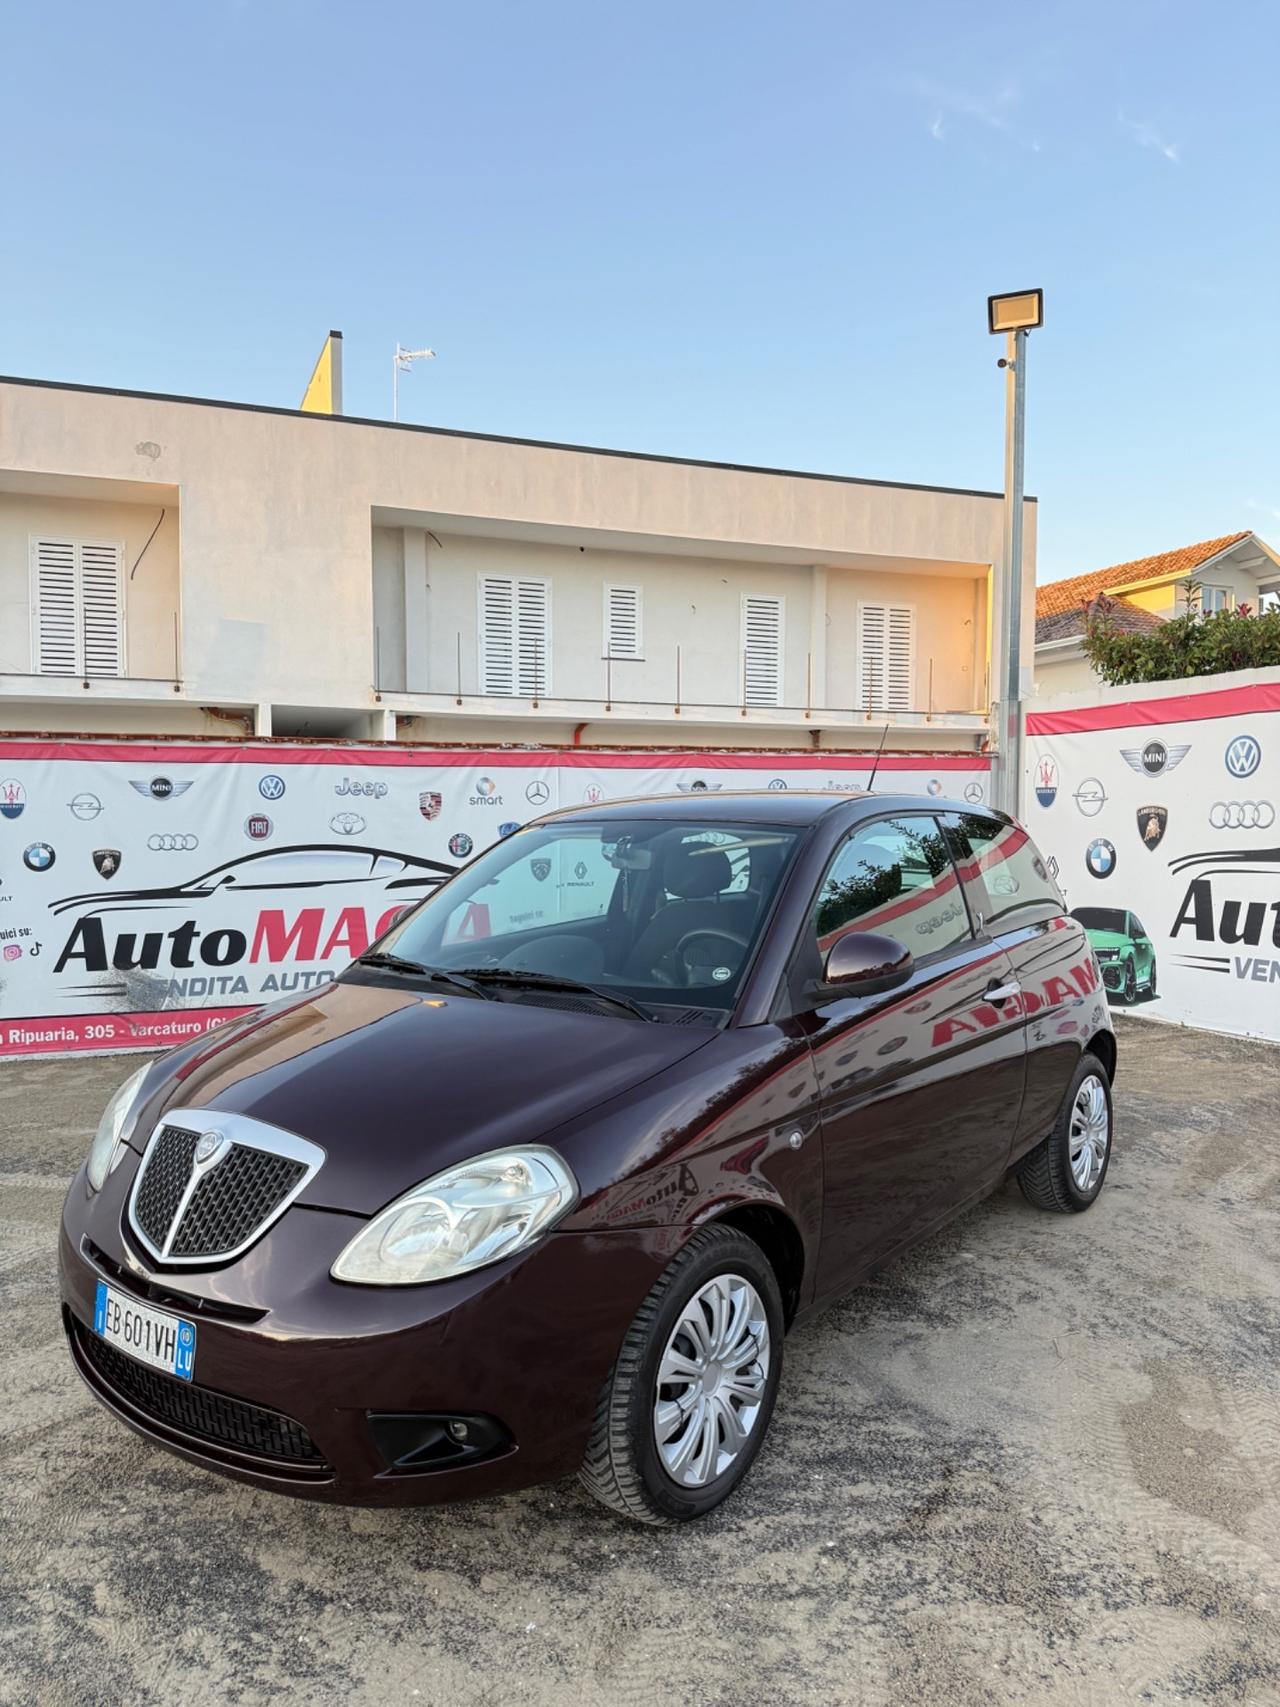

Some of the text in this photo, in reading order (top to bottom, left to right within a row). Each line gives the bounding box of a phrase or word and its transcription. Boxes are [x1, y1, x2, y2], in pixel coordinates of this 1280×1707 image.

[1144, 752, 1165, 763] MINI
[334, 778, 389, 800] Jeep
[469, 795, 503, 806] smart
[250, 821, 267, 834] FIAT
[9, 1026, 79, 1045] Ripuaria,
[84, 1024, 115, 1039] 305
[129, 1021, 202, 1037] Varcaturo
[177, 1347, 192, 1371] LU
